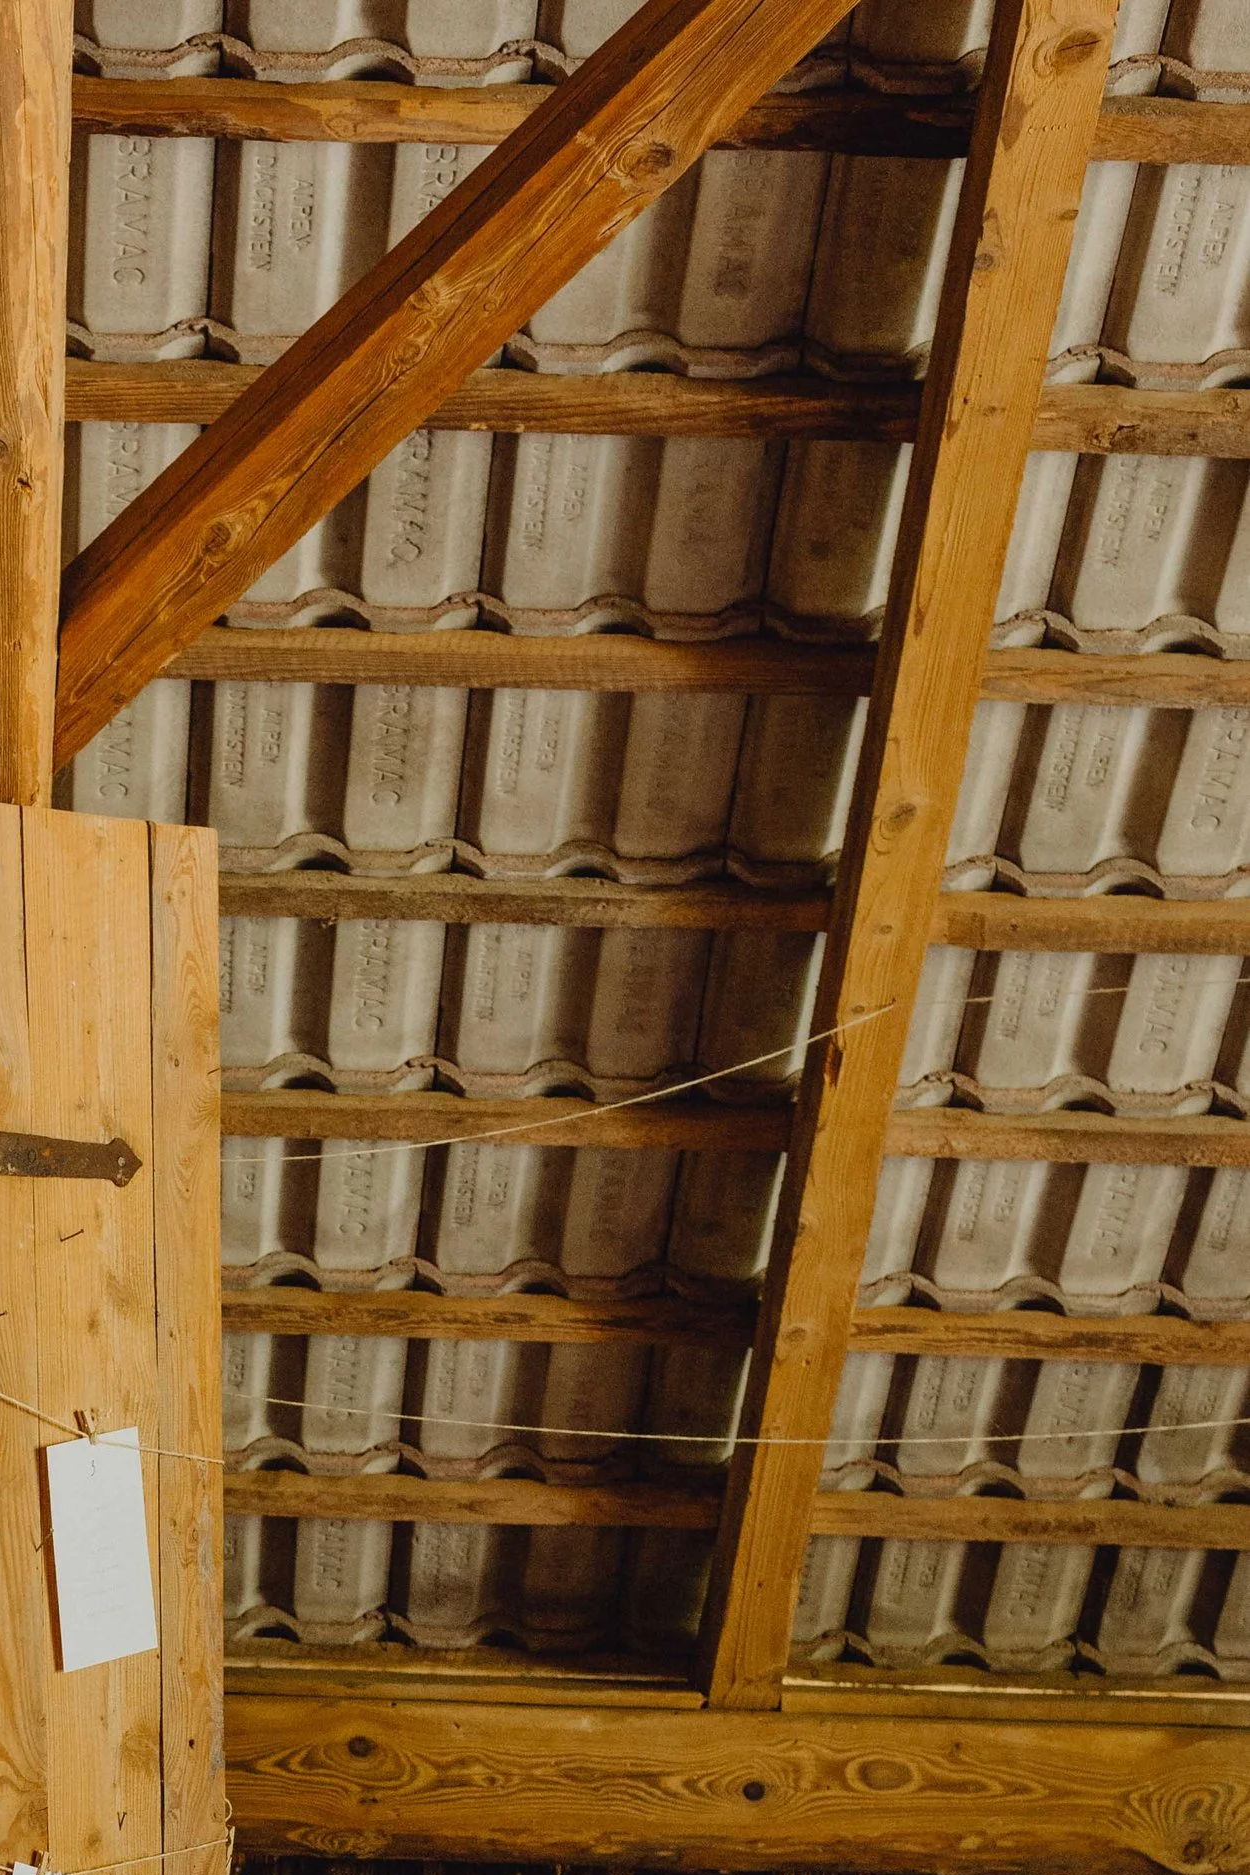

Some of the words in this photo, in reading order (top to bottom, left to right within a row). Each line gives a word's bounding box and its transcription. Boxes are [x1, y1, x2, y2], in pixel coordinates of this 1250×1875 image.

[111, 139, 152, 287] BRAMAC
[249, 155, 277, 273] DACHSTEIN
[287, 177, 315, 253] ALPEN
[417, 144, 460, 219] BRA
[1156, 176, 1201, 296] DACHSTEIN
[1199, 202, 1235, 268] ALPEN
[104, 422, 141, 515] BRAM
[93, 714, 132, 801] AMAC
[220, 688, 248, 790] DACHSTEIN
[1137, 958, 1189, 1053] RAMAC
[337, 1140, 373, 1236] RAMAC
[1090, 1170, 1139, 1258] RAMAC
